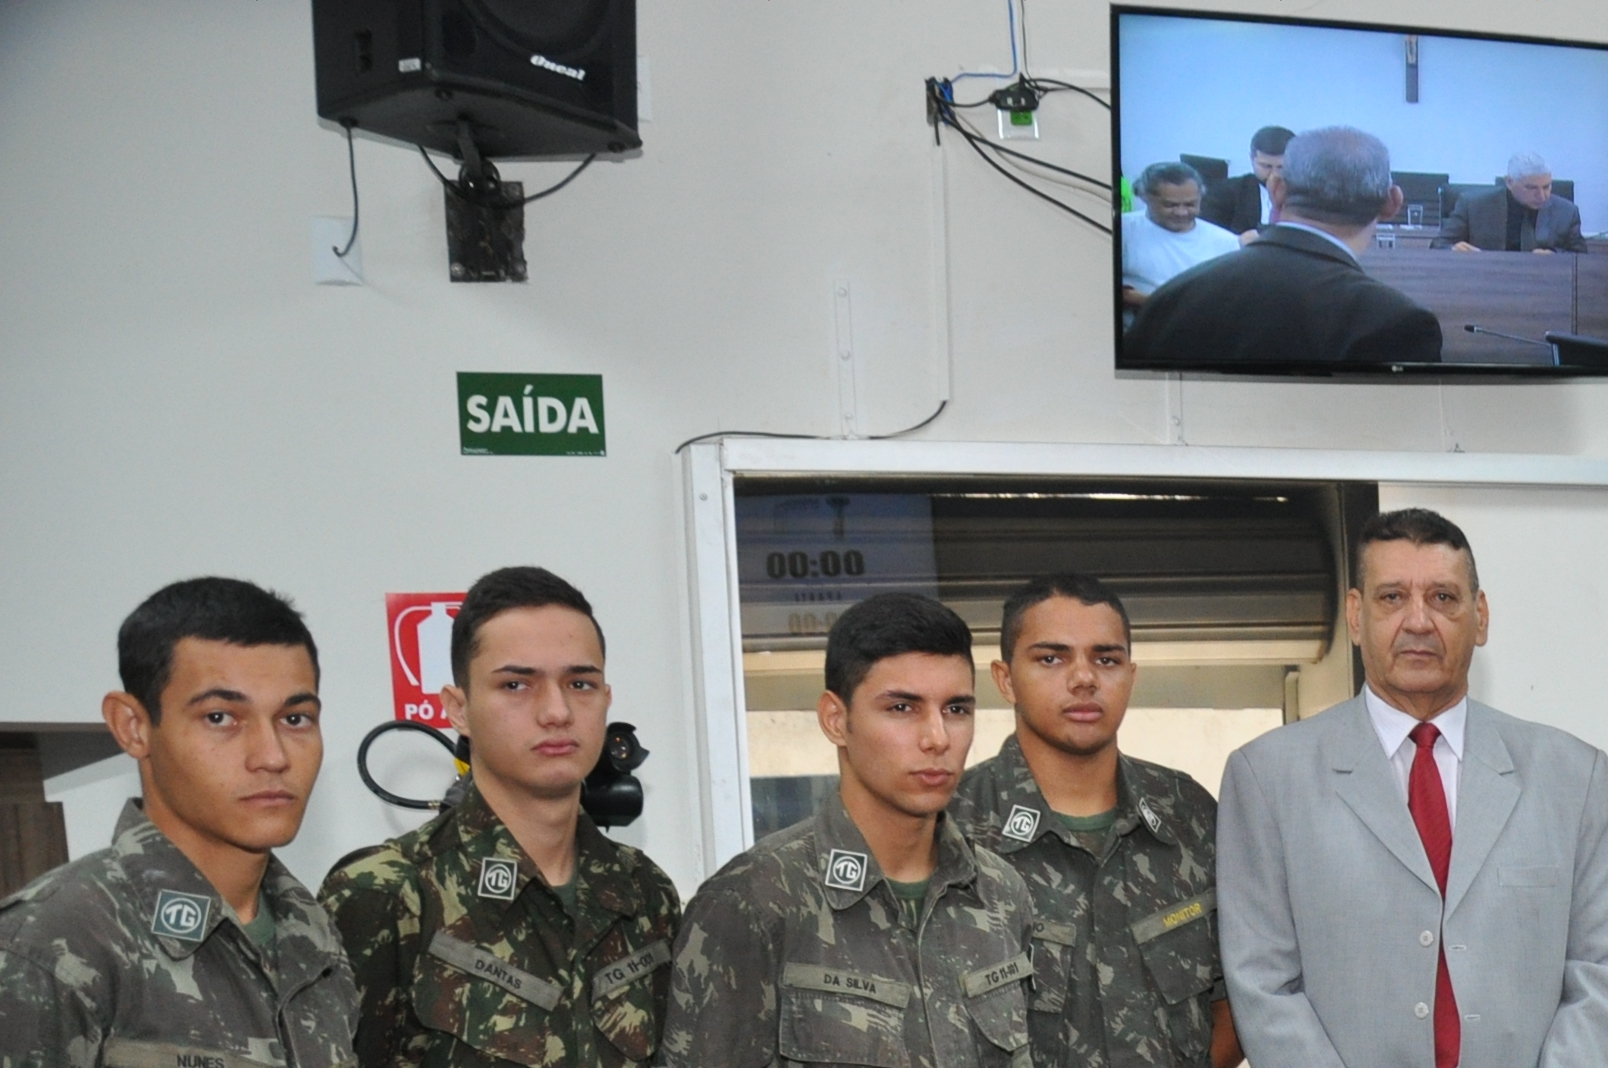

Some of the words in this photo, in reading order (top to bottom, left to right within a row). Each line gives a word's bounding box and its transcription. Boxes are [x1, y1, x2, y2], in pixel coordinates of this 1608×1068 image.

[466, 384, 600, 434] SAÍDA
[766, 549, 865, 579] 00:00
[404, 699, 435, 720] PÓ
[1014, 814, 1032, 832] TG
[487, 867, 509, 889] TG
[835, 861, 859, 880] TG
[165, 903, 197, 928] TG
[1162, 902, 1203, 928] MONITOR
[474, 959, 522, 990] DANTAS
[604, 967, 626, 986] TG
[823, 973, 841, 987] DA
[846, 976, 877, 995] SILVA
[984, 973, 1000, 986] TG
